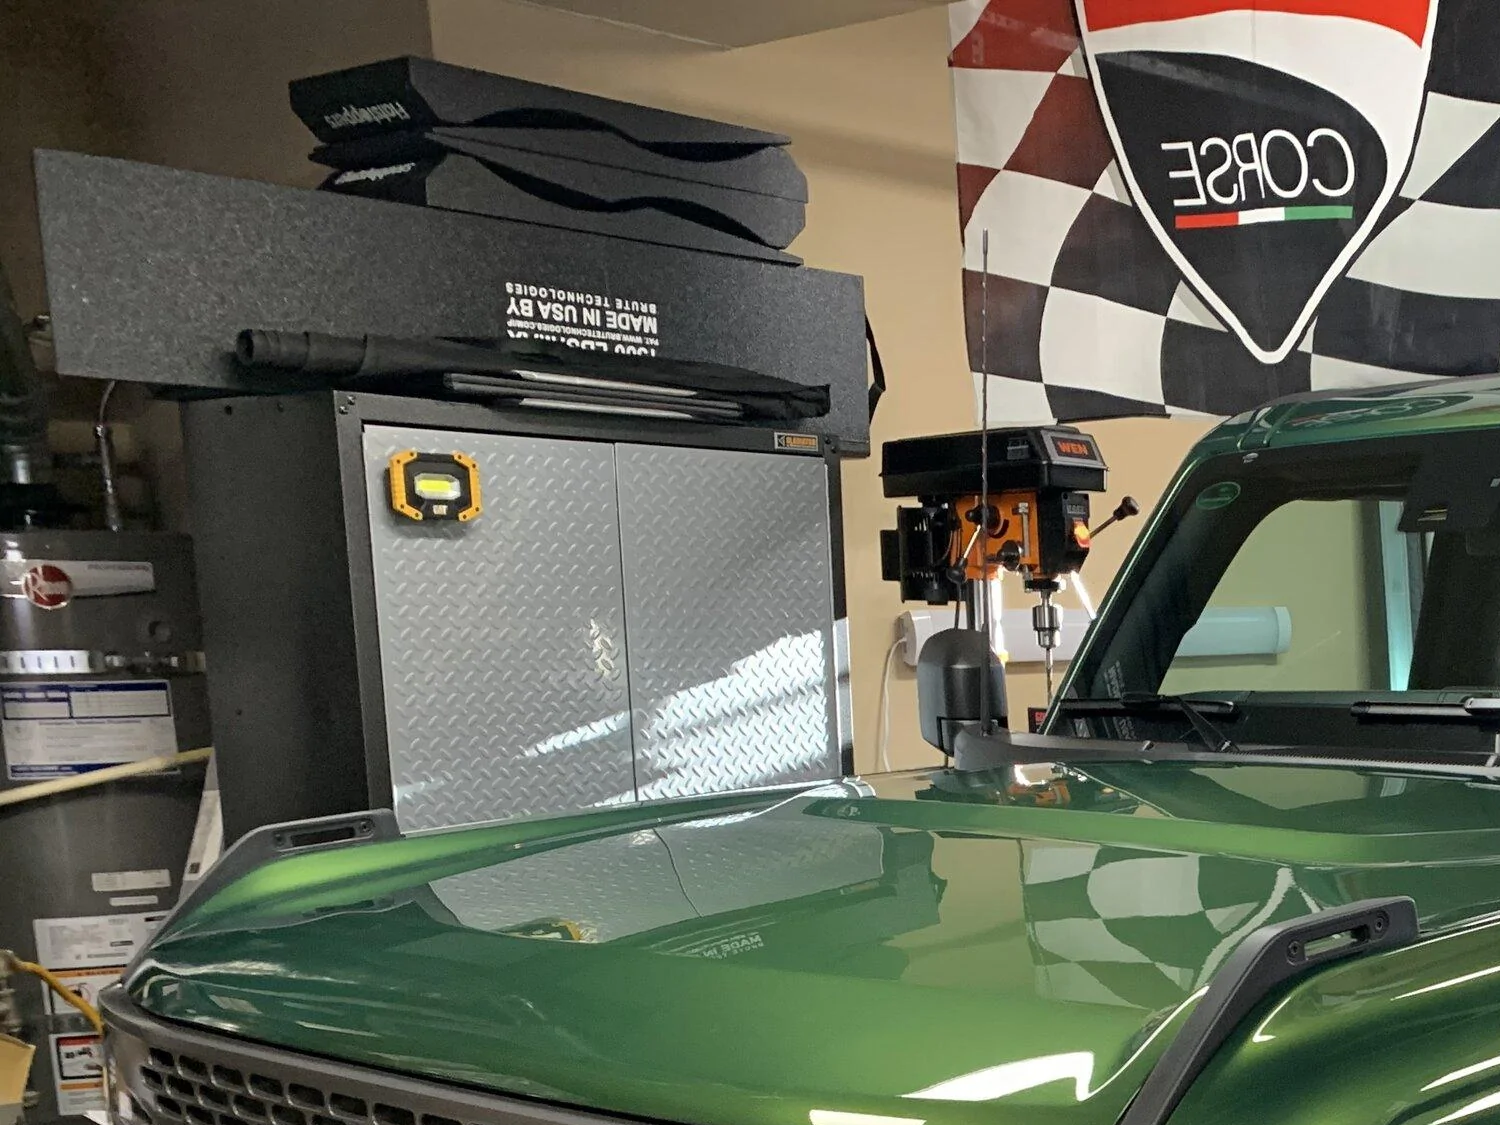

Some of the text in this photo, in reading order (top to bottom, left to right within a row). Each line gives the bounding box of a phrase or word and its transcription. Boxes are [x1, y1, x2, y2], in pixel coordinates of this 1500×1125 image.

[505, 281, 658, 315] BRUTE TECHNOLOGIES
[506, 296, 658, 335] MADE IN USA BY
